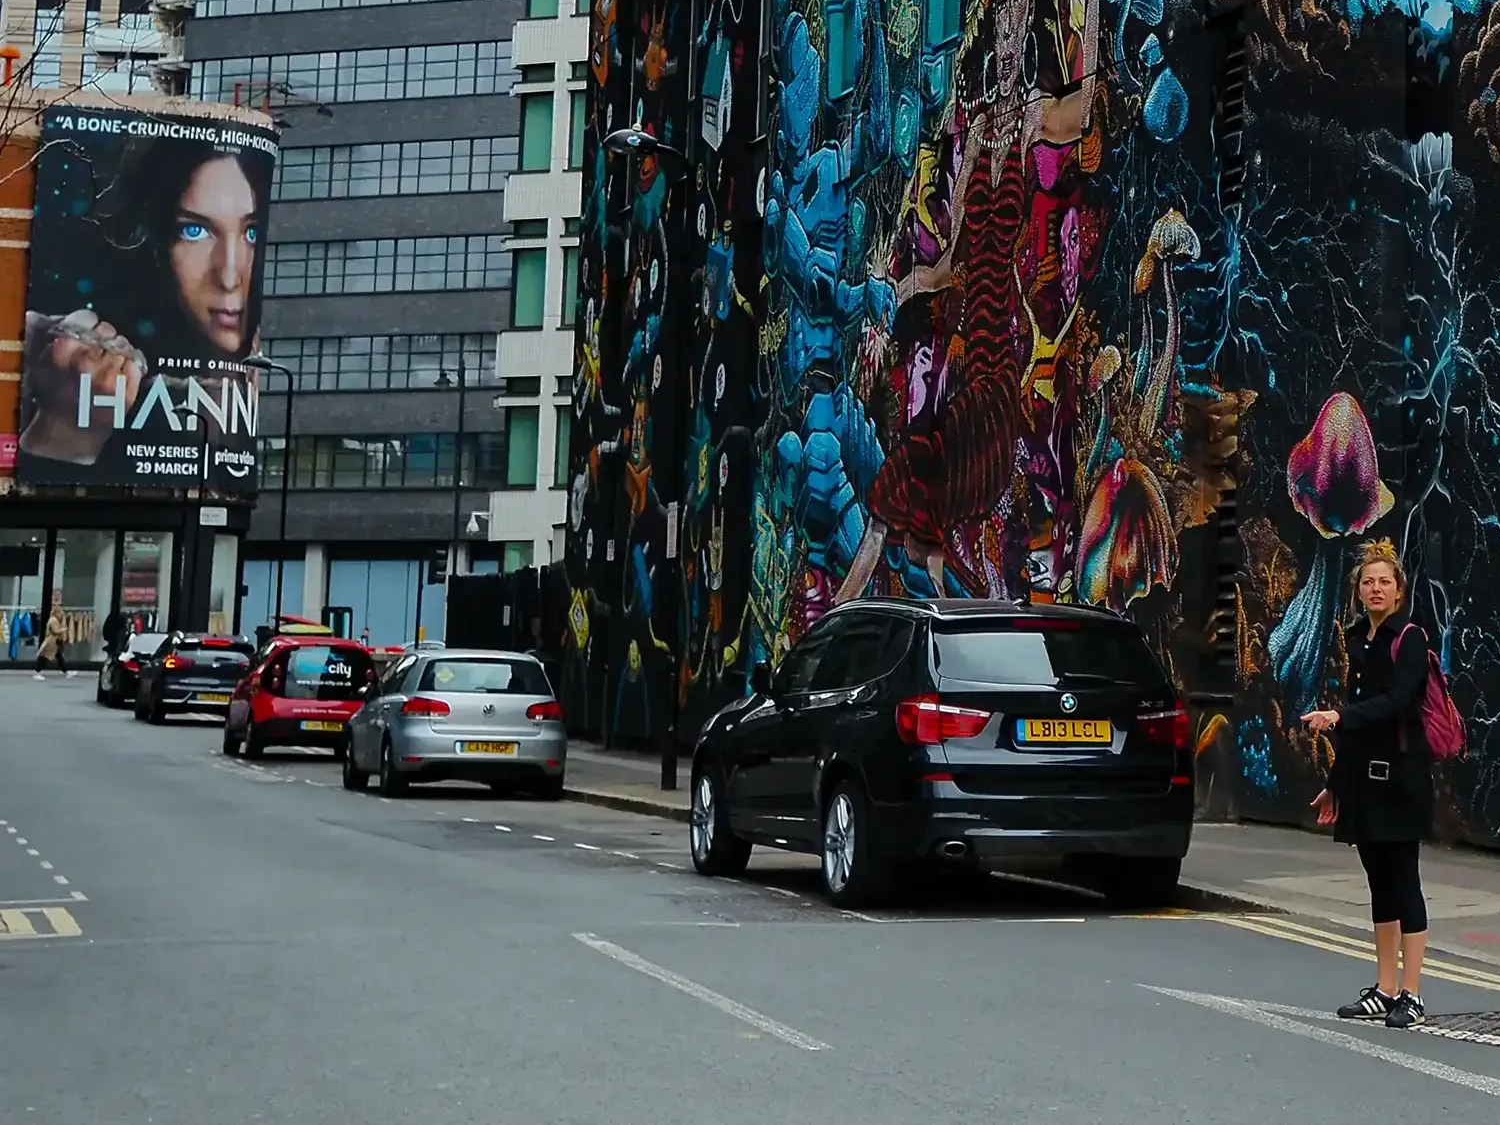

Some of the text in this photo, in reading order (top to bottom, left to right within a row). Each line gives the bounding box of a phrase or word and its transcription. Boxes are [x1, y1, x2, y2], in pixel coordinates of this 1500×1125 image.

[77, 117, 219, 144] BONE-CRUNCHING,
[158, 357, 247, 373] PRIME ORIGINAL
[126, 444, 199, 459] NEW SERIES
[215, 448, 239, 465] prime
[136, 461, 198, 475] 29 MARCH
[328, 662, 352, 678] city
[1030, 721, 1104, 738] LB13 LCL
